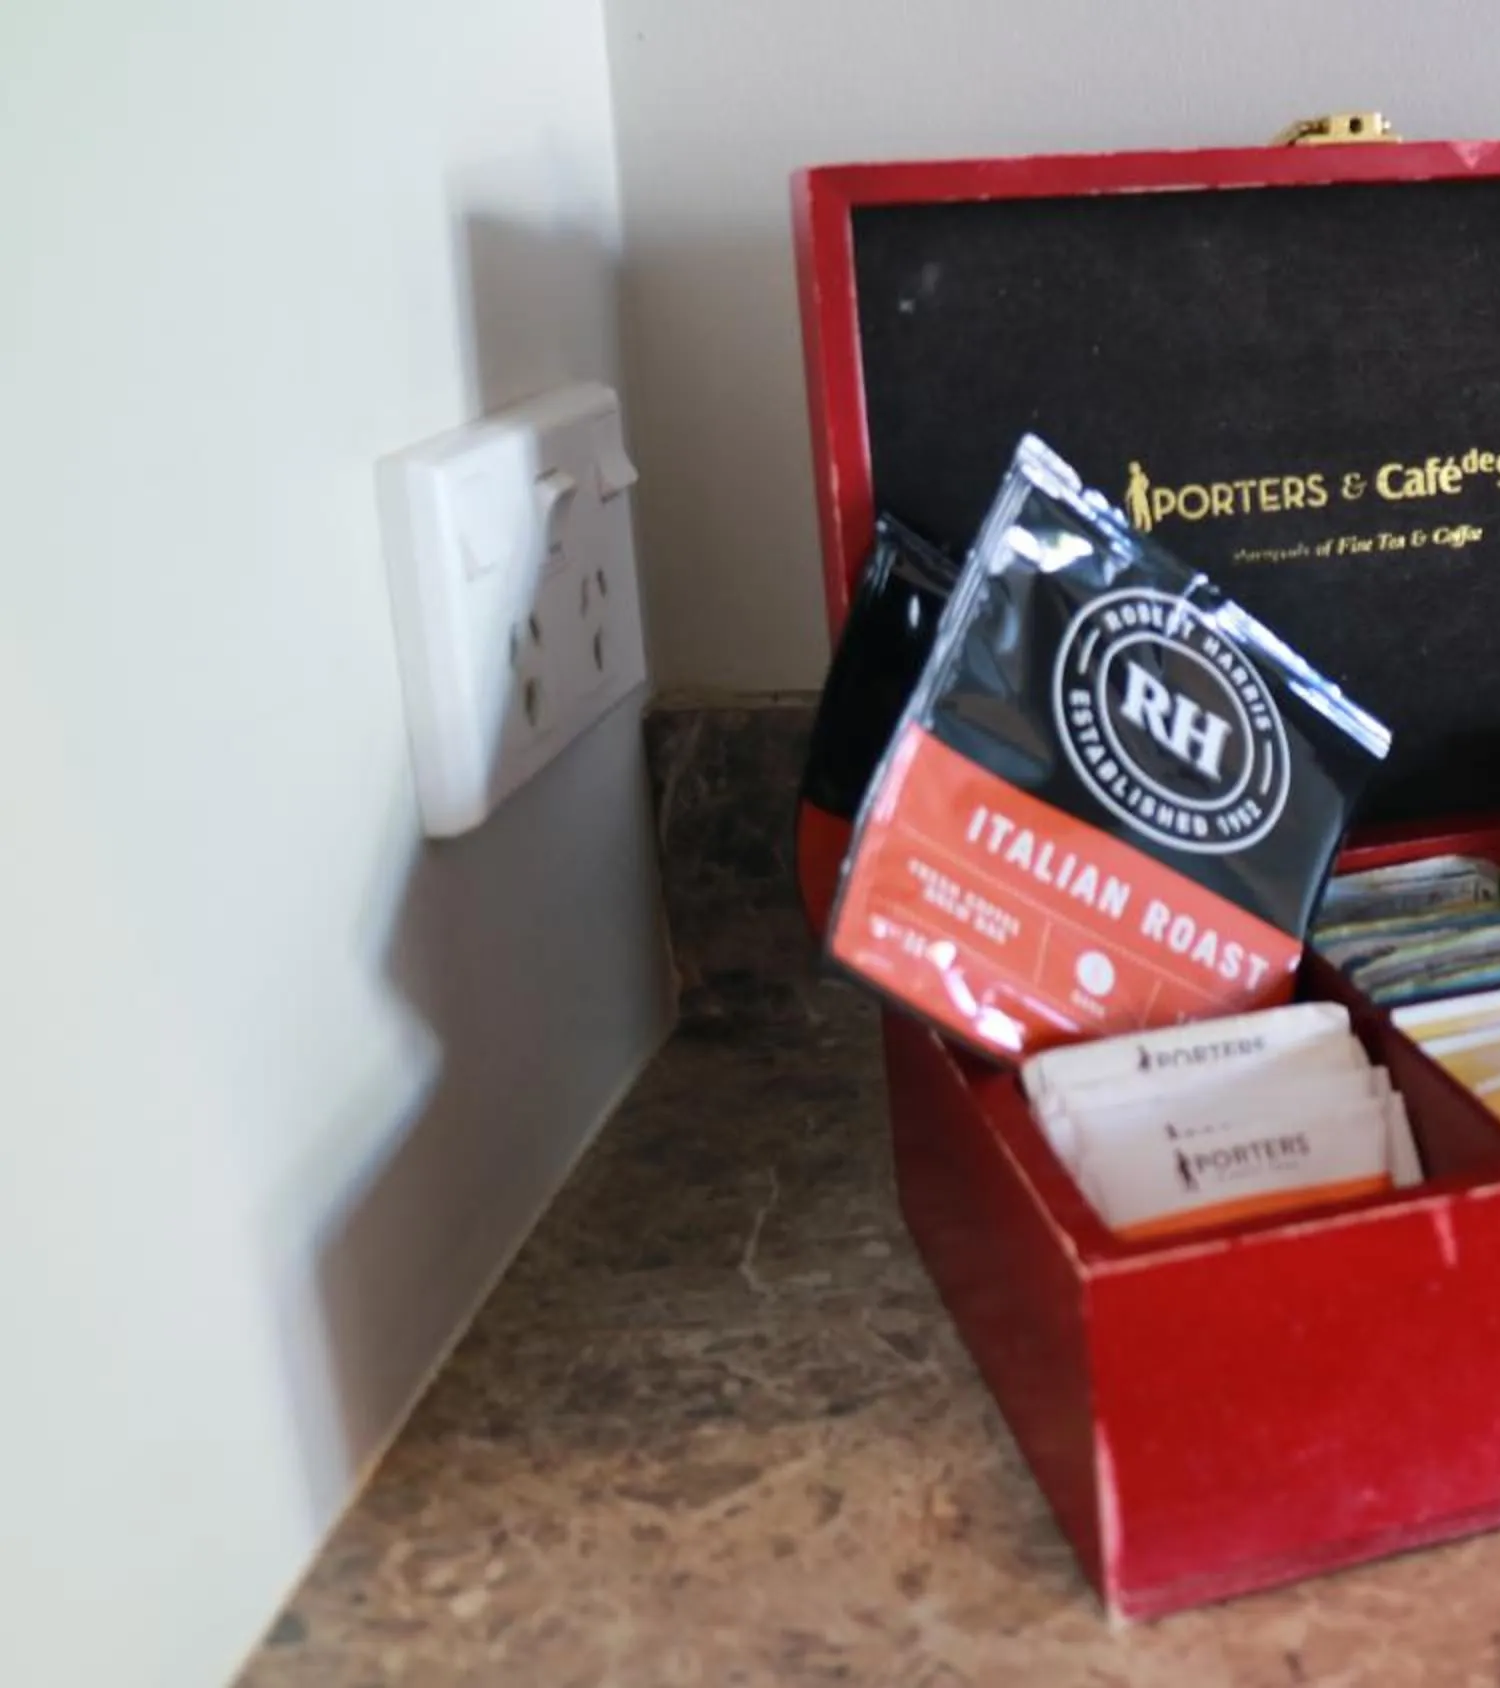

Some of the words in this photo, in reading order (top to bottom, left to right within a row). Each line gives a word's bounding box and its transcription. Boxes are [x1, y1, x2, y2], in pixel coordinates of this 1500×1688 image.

[1152, 475, 1328, 523] PORTERS
[1342, 472, 1367, 500] &
[1120, 660, 1233, 783] RH
[1202, 636, 1272, 733] HARRIS
[1068, 688, 1208, 837] ESTABLISHED
[965, 805, 1132, 920] ITALIAN
[1140, 899, 1270, 990] ROAST
[1193, 1132, 1310, 1173] PORTERS
